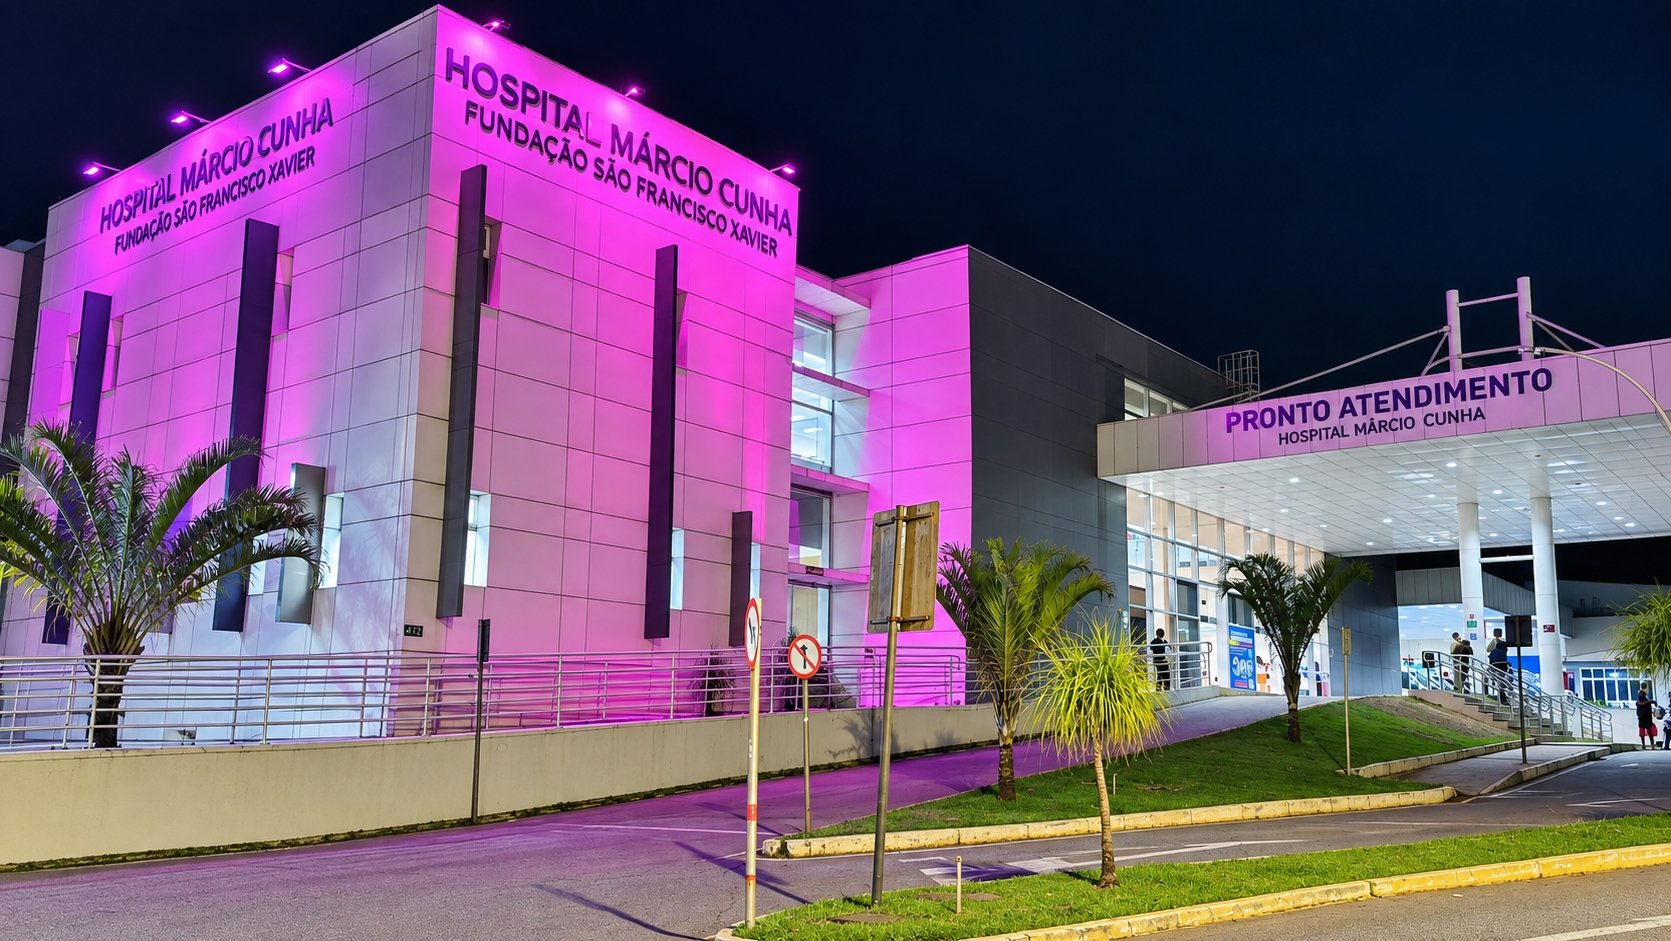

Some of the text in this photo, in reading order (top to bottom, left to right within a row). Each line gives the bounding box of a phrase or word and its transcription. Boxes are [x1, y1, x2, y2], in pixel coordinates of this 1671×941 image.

[100, 97, 334, 234] HOSPITAL MÁRCIO CUNHA
[114, 145, 315, 256] FUNDAÇÃO SÃO FRANCISCO XAVIER
[445, 47, 792, 237] HOSPITAL MÁRCIO CUNHA
[465, 99, 778, 258] FUNDAÇÃO SÃO FRANCISCO XAVIER
[1225, 367, 1553, 434] PRONTO ATENDIMENTO
[1278, 425, 1350, 446] HOSPITAL
[1423, 406, 1486, 428] CUNHA
